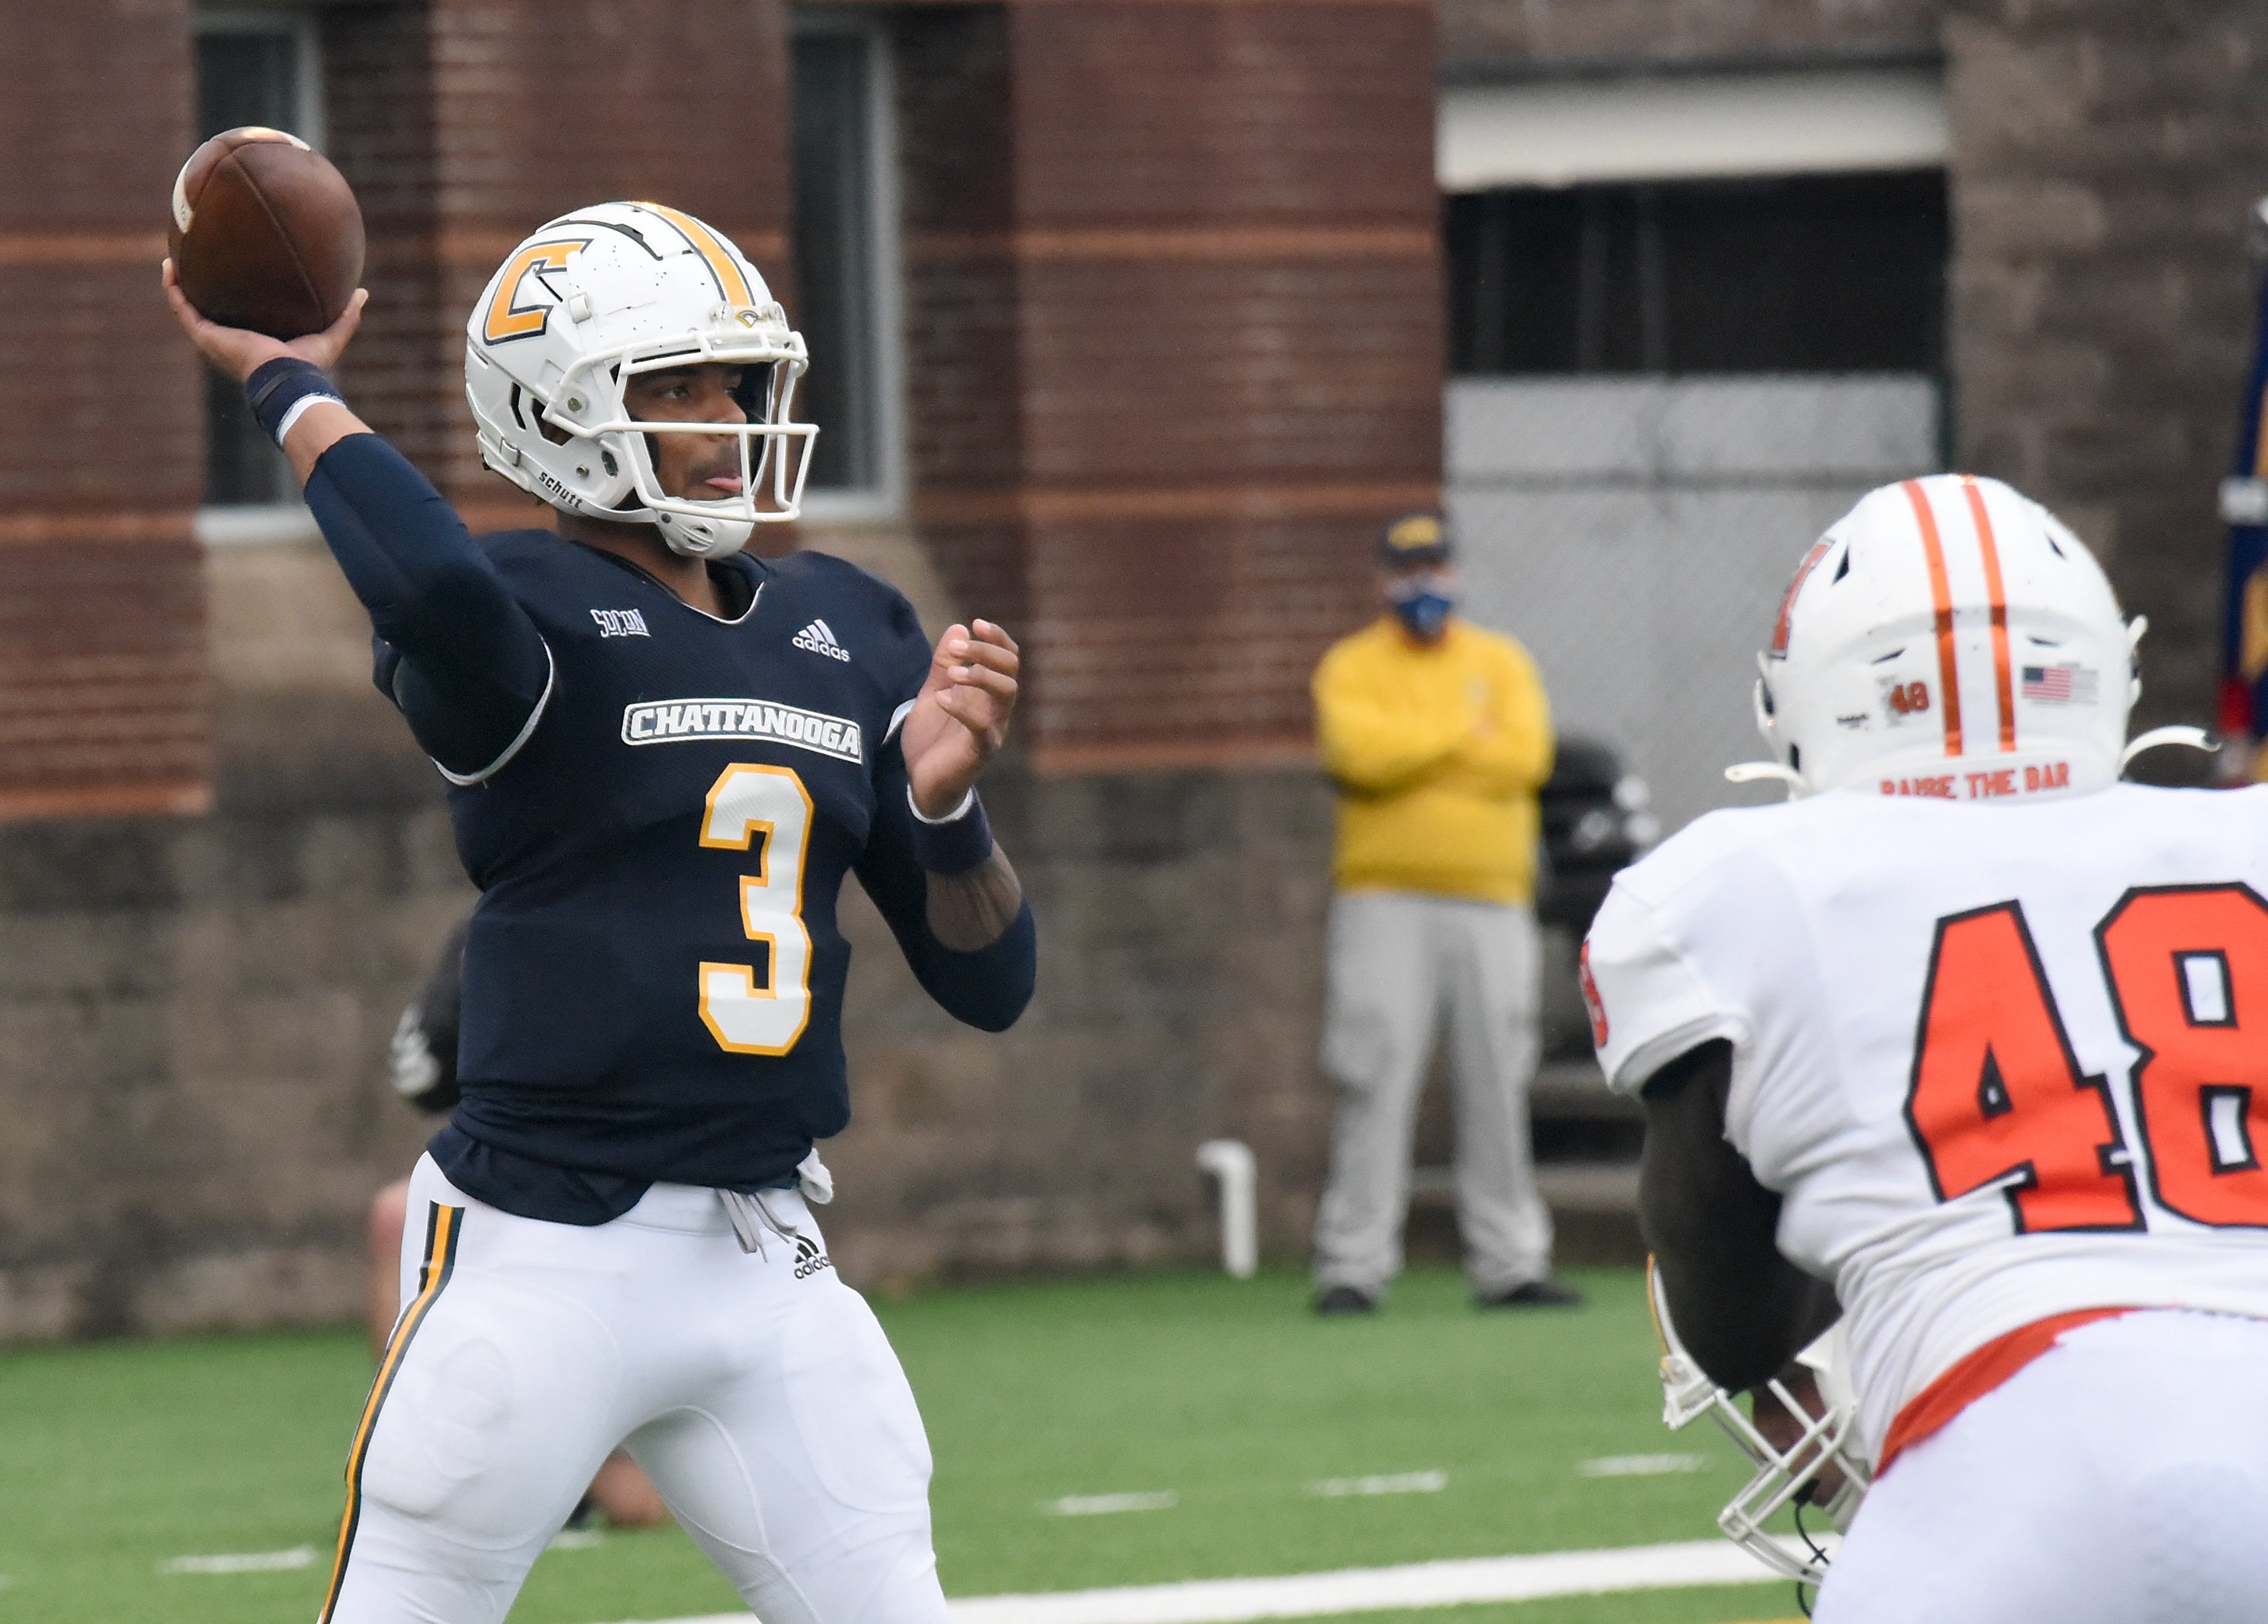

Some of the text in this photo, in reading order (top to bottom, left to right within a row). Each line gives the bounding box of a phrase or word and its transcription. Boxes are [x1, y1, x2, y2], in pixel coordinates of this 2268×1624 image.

[482, 238, 594, 346] C
[538, 470, 583, 508] schutt
[590, 608, 651, 637] SOCON
[792, 636, 850, 662] adidas
[1888, 681, 1929, 715] 48
[630, 705, 858, 755] CHATTANOOGA
[1965, 769, 2016, 798] THE
[2024, 762, 2070, 792] BAR
[698, 762, 815, 1056] 3
[1903, 882, 2268, 1235] 48
